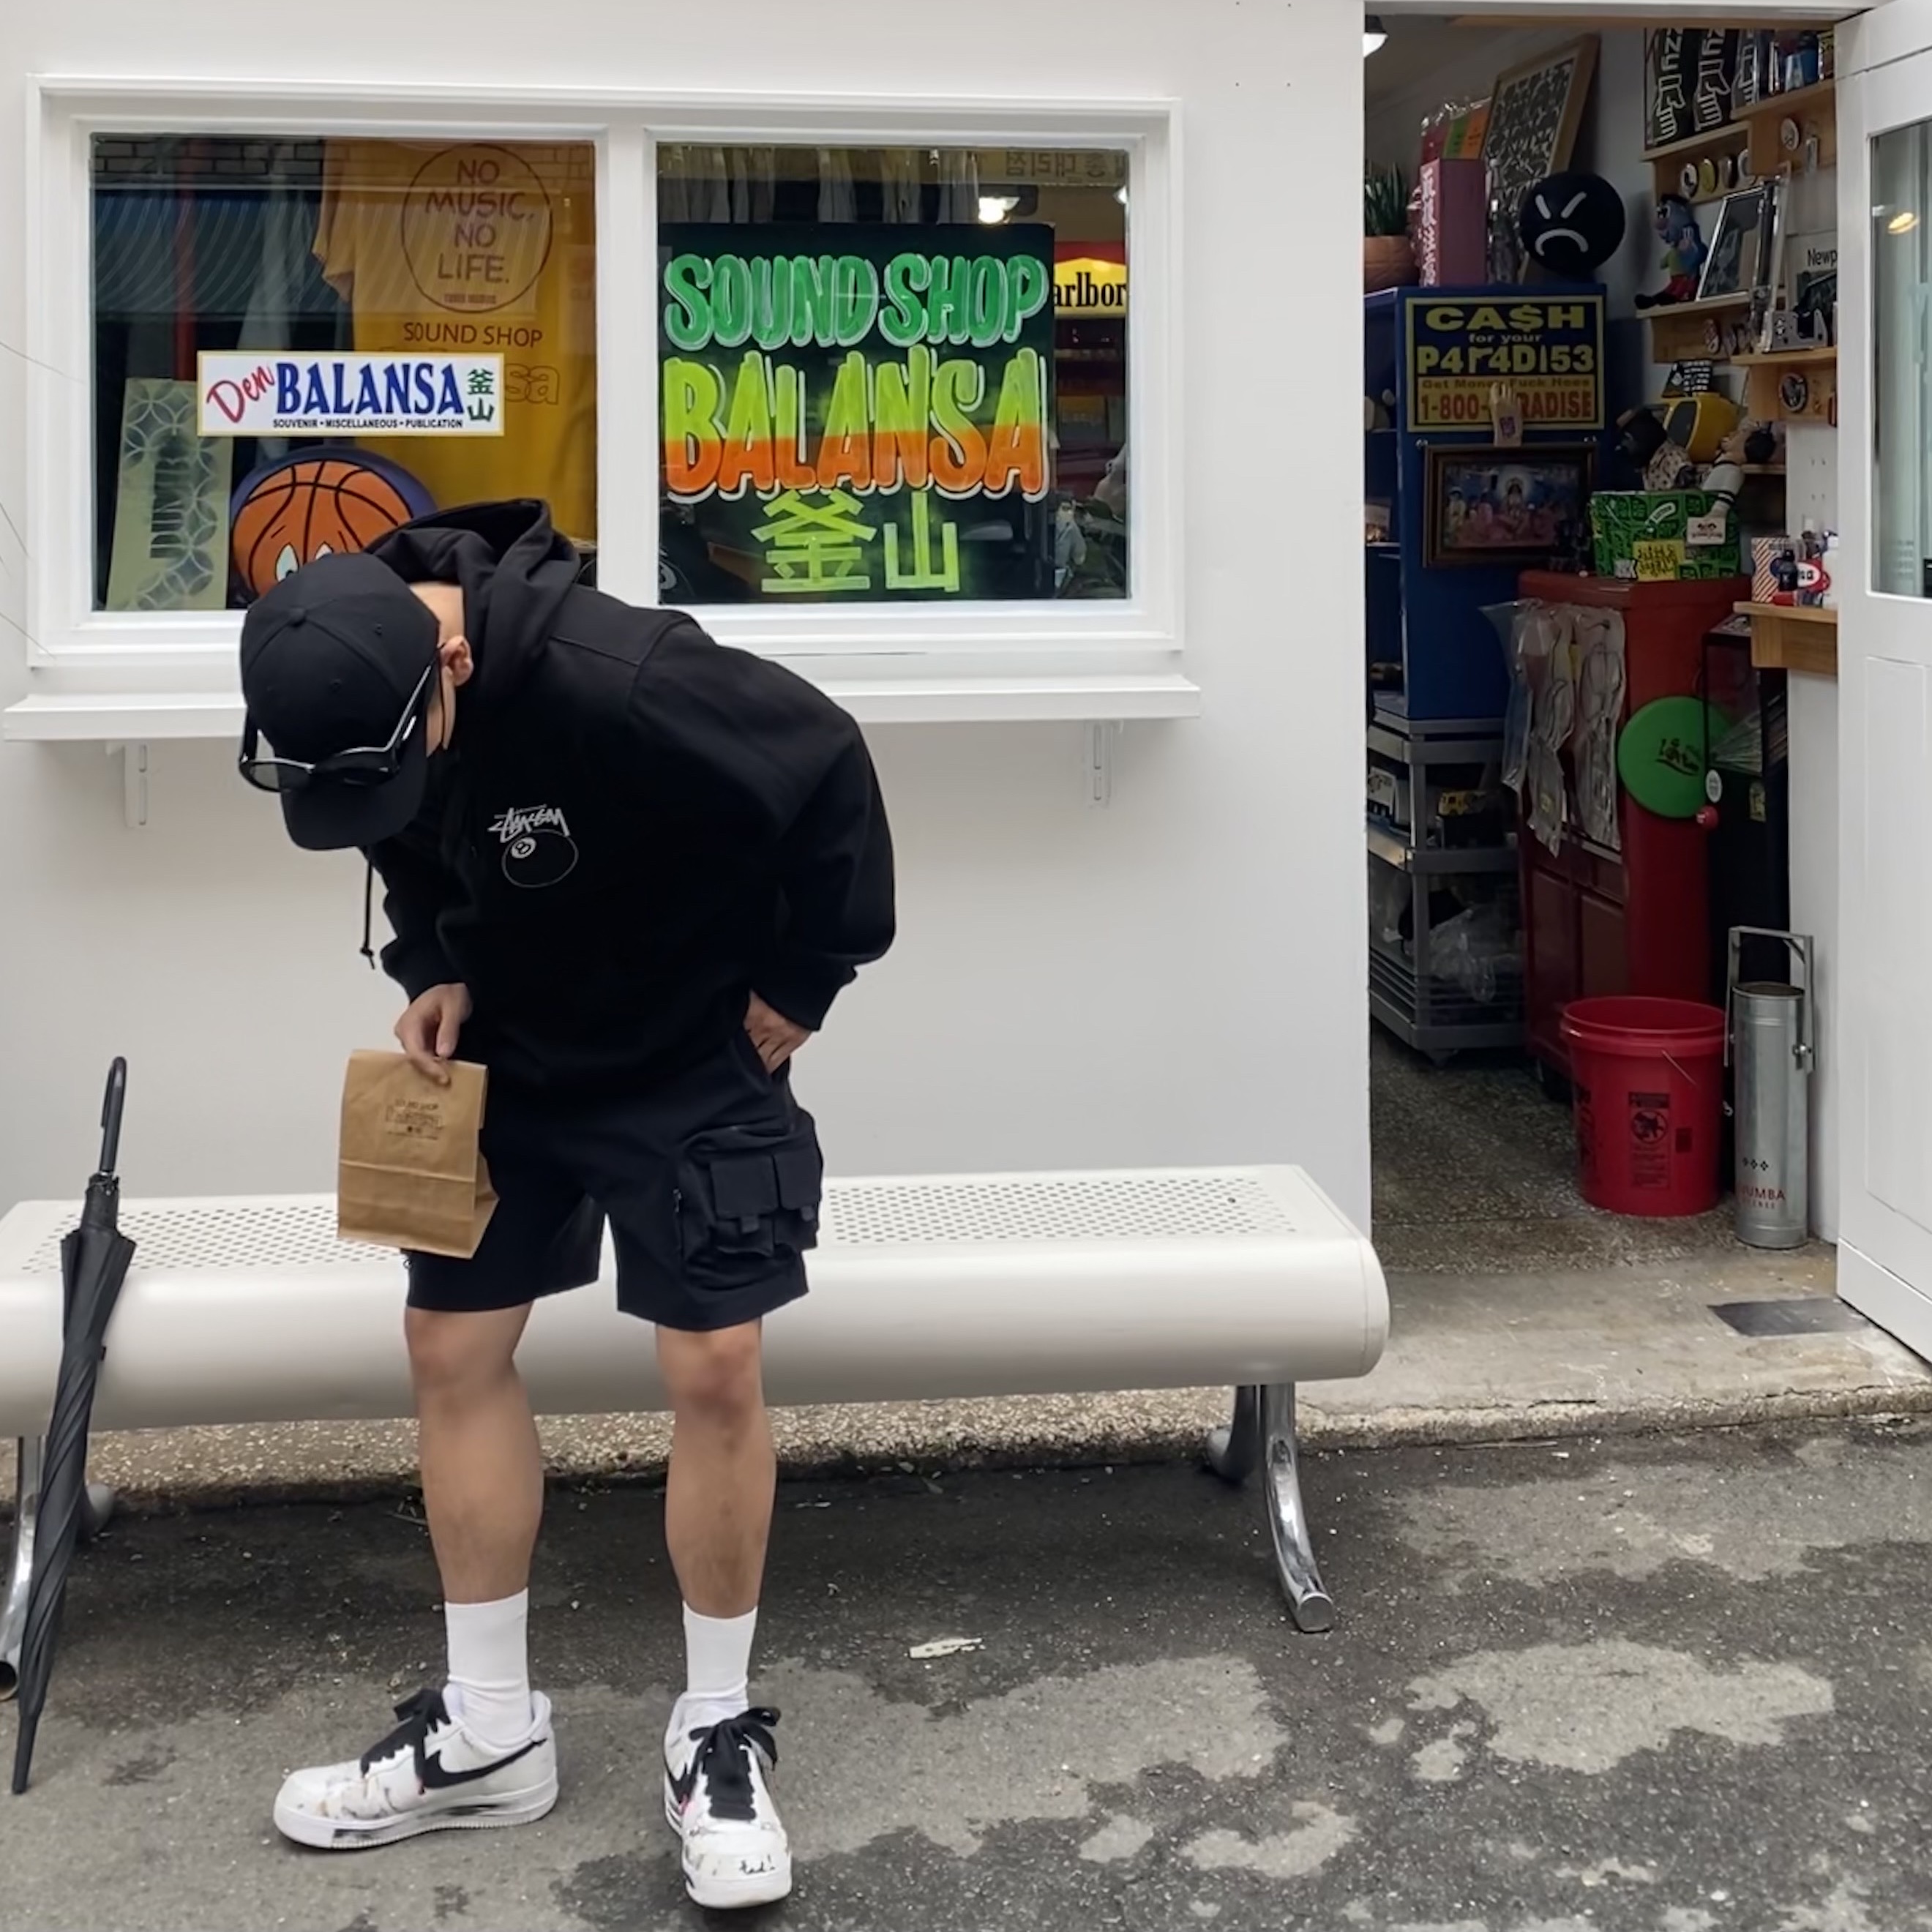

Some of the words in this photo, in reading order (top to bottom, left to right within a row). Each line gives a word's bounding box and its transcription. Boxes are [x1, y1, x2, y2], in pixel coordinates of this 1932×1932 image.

[457, 159, 500, 184] NO
[454, 222, 496, 249] NO
[438, 253, 510, 285] LIFE.
[664, 252, 878, 351] SOUND
[878, 252, 1049, 348] SHOP
[1426, 304, 1585, 332] CA$H
[403, 322, 477, 345] SOUND
[482, 325, 543, 348] SHOP
[1469, 334, 1495, 343] for
[1501, 334, 1543, 344] your
[206, 364, 275, 424] Den
[275, 362, 465, 416] BALANSA
[466, 367, 495, 422] 釜山
[1422, 381, 1450, 390] Get
[273, 419, 318, 428] SOUVENIR
[325, 419, 398, 429] MISCELLANEOUS
[405, 419, 463, 429] PUBLICATION
[662, 344, 1049, 503] BALANSA
